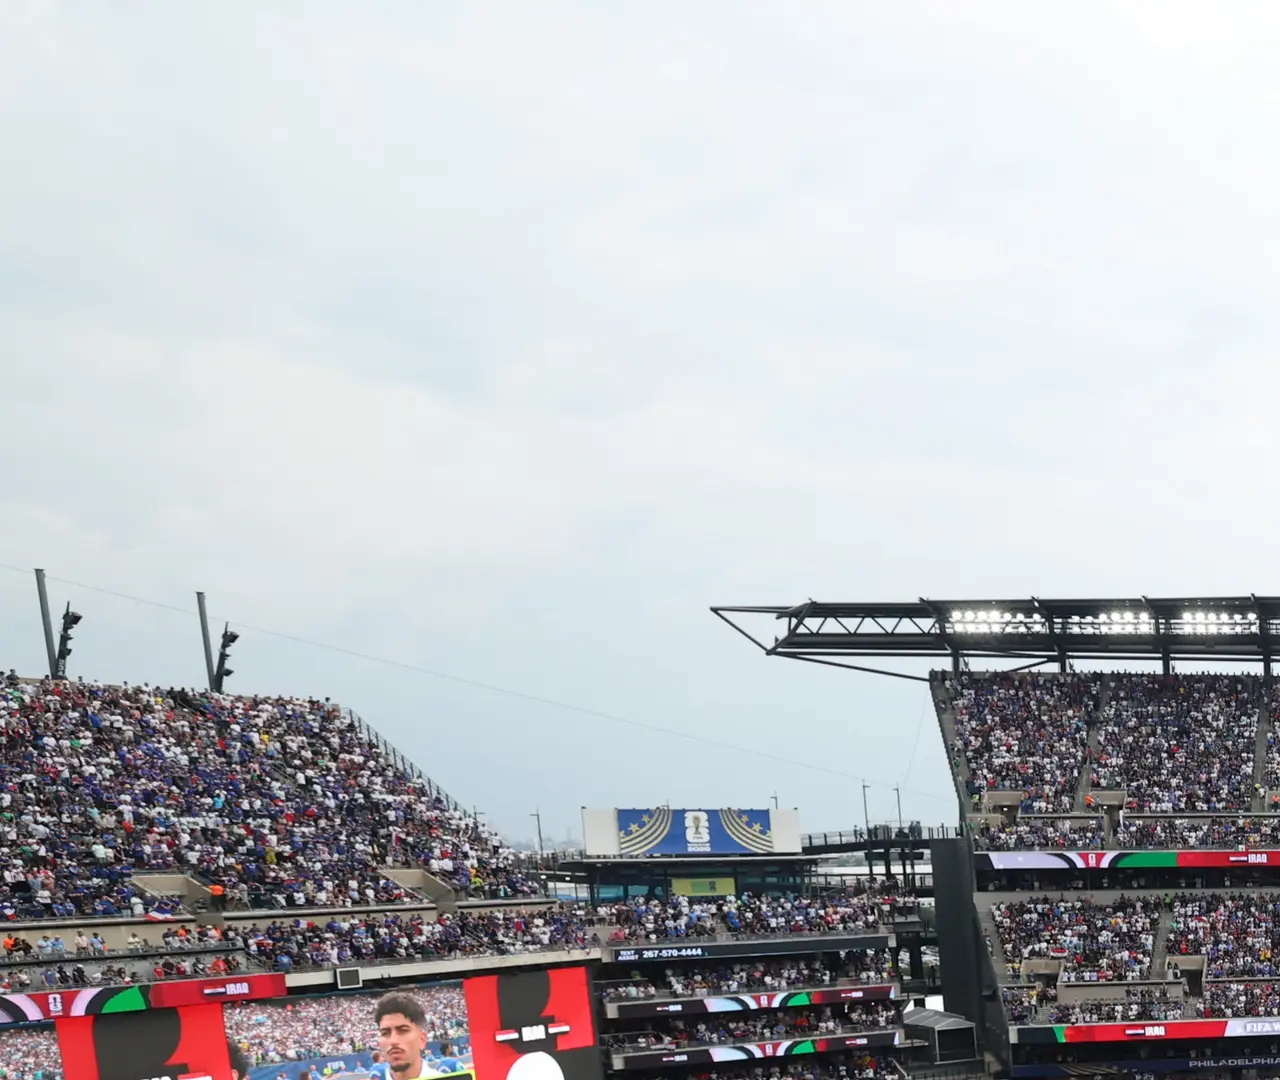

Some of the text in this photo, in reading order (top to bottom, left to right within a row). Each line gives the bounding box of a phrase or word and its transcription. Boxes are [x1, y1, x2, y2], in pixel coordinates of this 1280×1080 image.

[1248, 853, 1268, 863] IRAQ
[226, 982, 248, 995] IRAQ
[1145, 1026, 1165, 1036] IRAQ
[1246, 1022, 1273, 1033] FIFA
